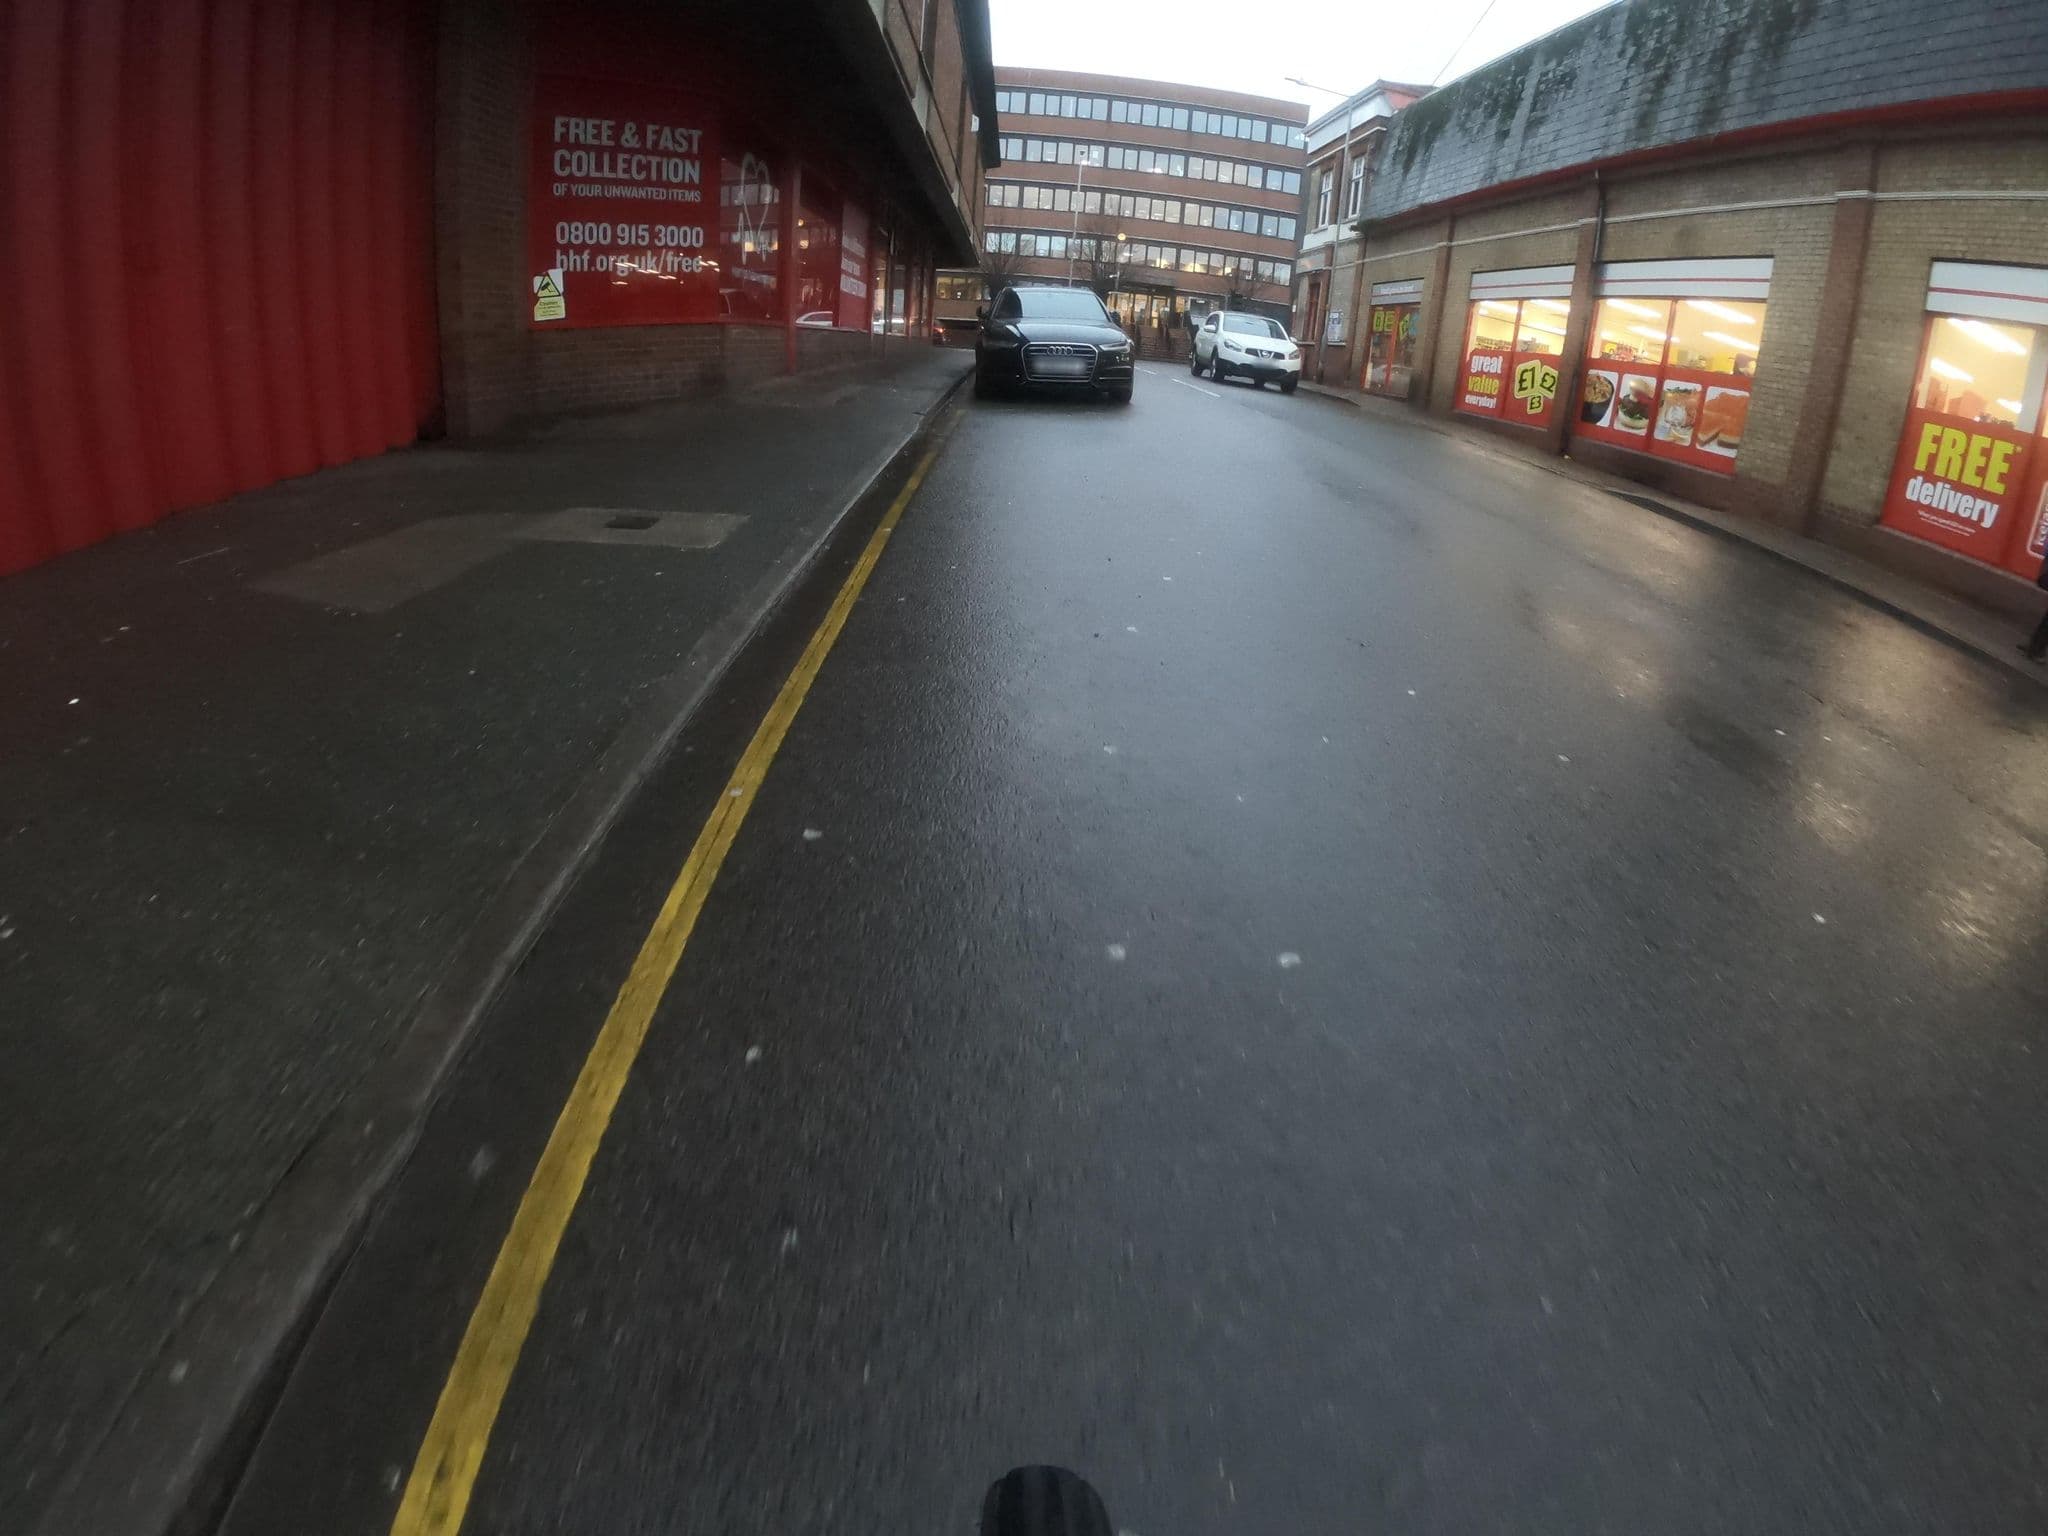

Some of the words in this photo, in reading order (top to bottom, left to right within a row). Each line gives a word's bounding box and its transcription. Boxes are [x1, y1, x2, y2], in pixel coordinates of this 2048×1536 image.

[553, 115, 616, 146] FREE
[620, 121, 642, 149] &
[646, 124, 703, 155] FAST
[553, 149, 701, 185] COLLECTION
[552, 182, 569, 197] OF
[570, 183, 602, 198] YOUR
[604, 184, 667, 201] UNWANTED
[668, 188, 702, 203] ITEMS
[555, 221, 612, 246] 0800
[616, 223, 650, 247] 915
[654, 224, 704, 248] 3000
[555, 249, 704, 277] bhf.org.uk/free
[1470, 355, 1504, 375] great
[1467, 375, 1500, 396] value
[1517, 366, 1537, 393] £1
[1539, 371, 1557, 394] £2
[1905, 475, 2000, 529] delivery
